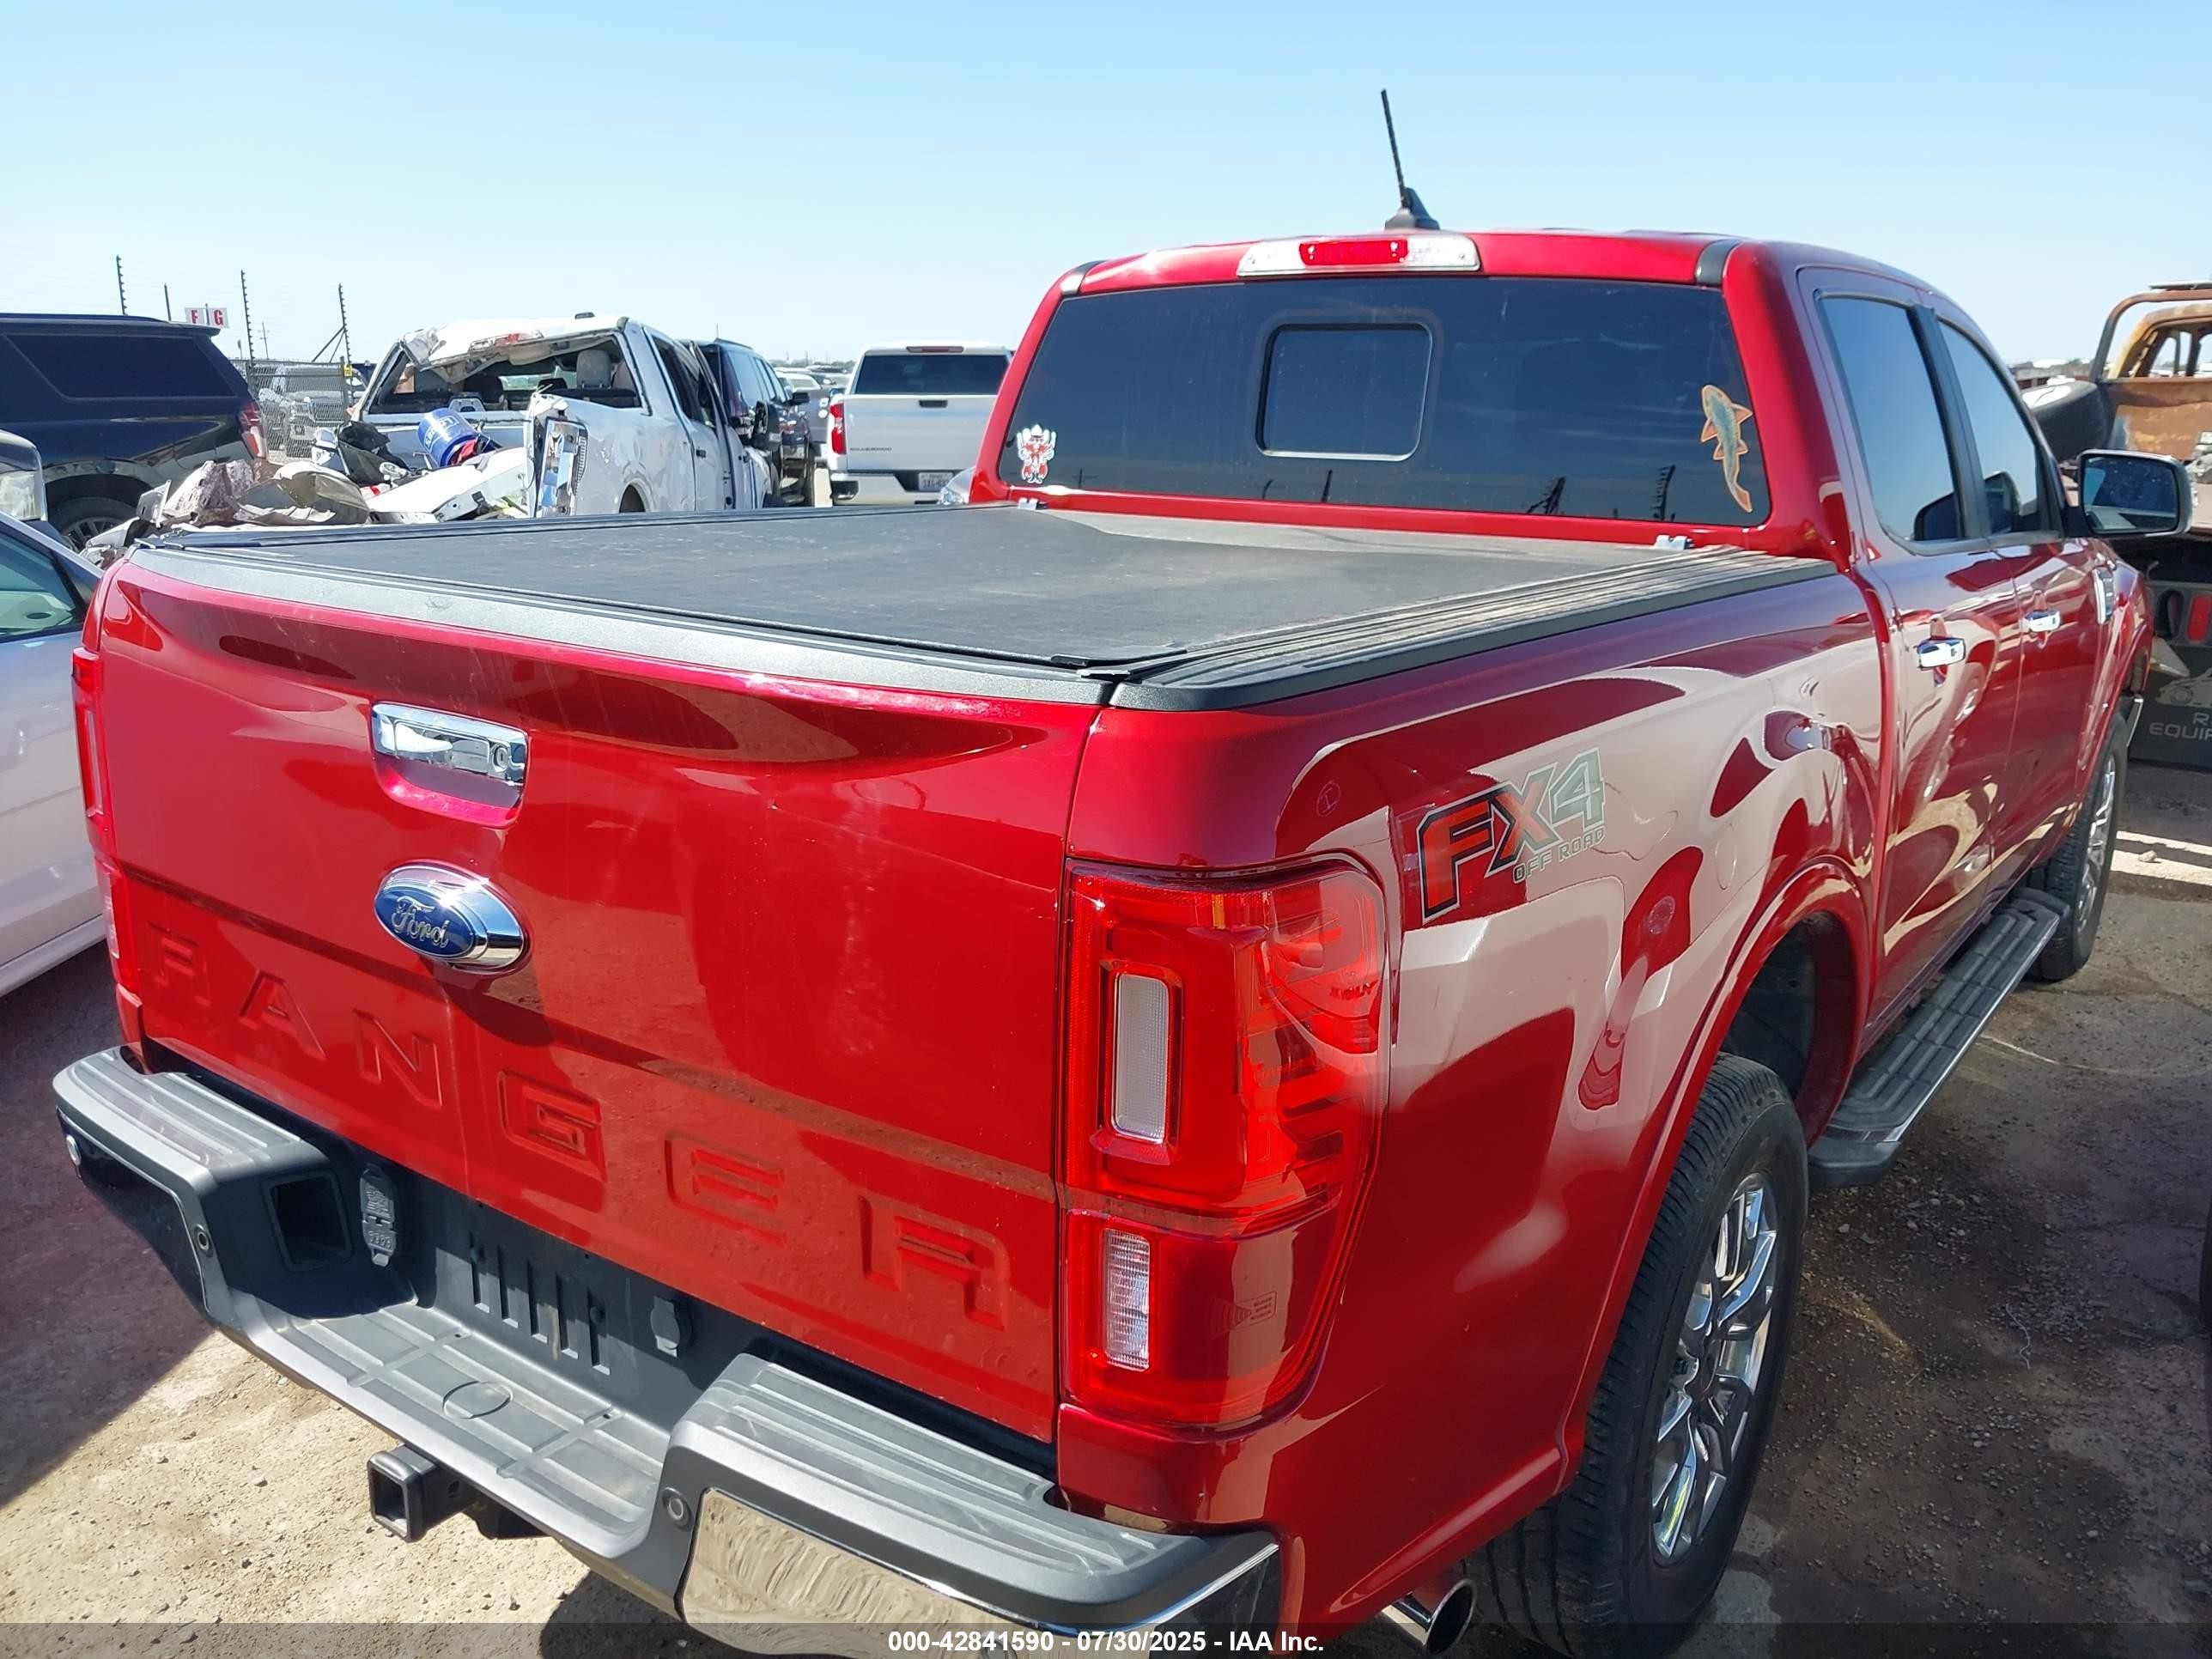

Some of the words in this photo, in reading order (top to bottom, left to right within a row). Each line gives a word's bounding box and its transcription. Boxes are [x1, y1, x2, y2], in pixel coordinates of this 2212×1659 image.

[191, 309, 198, 324] F
[214, 309, 224, 325] G
[1416, 747, 1606, 926] FX4
[1512, 850, 1553, 884] OFF
[1558, 825, 1606, 863] ROAD
[391, 895, 451, 949] Ford
[144, 920, 1012, 1332] RANGER
